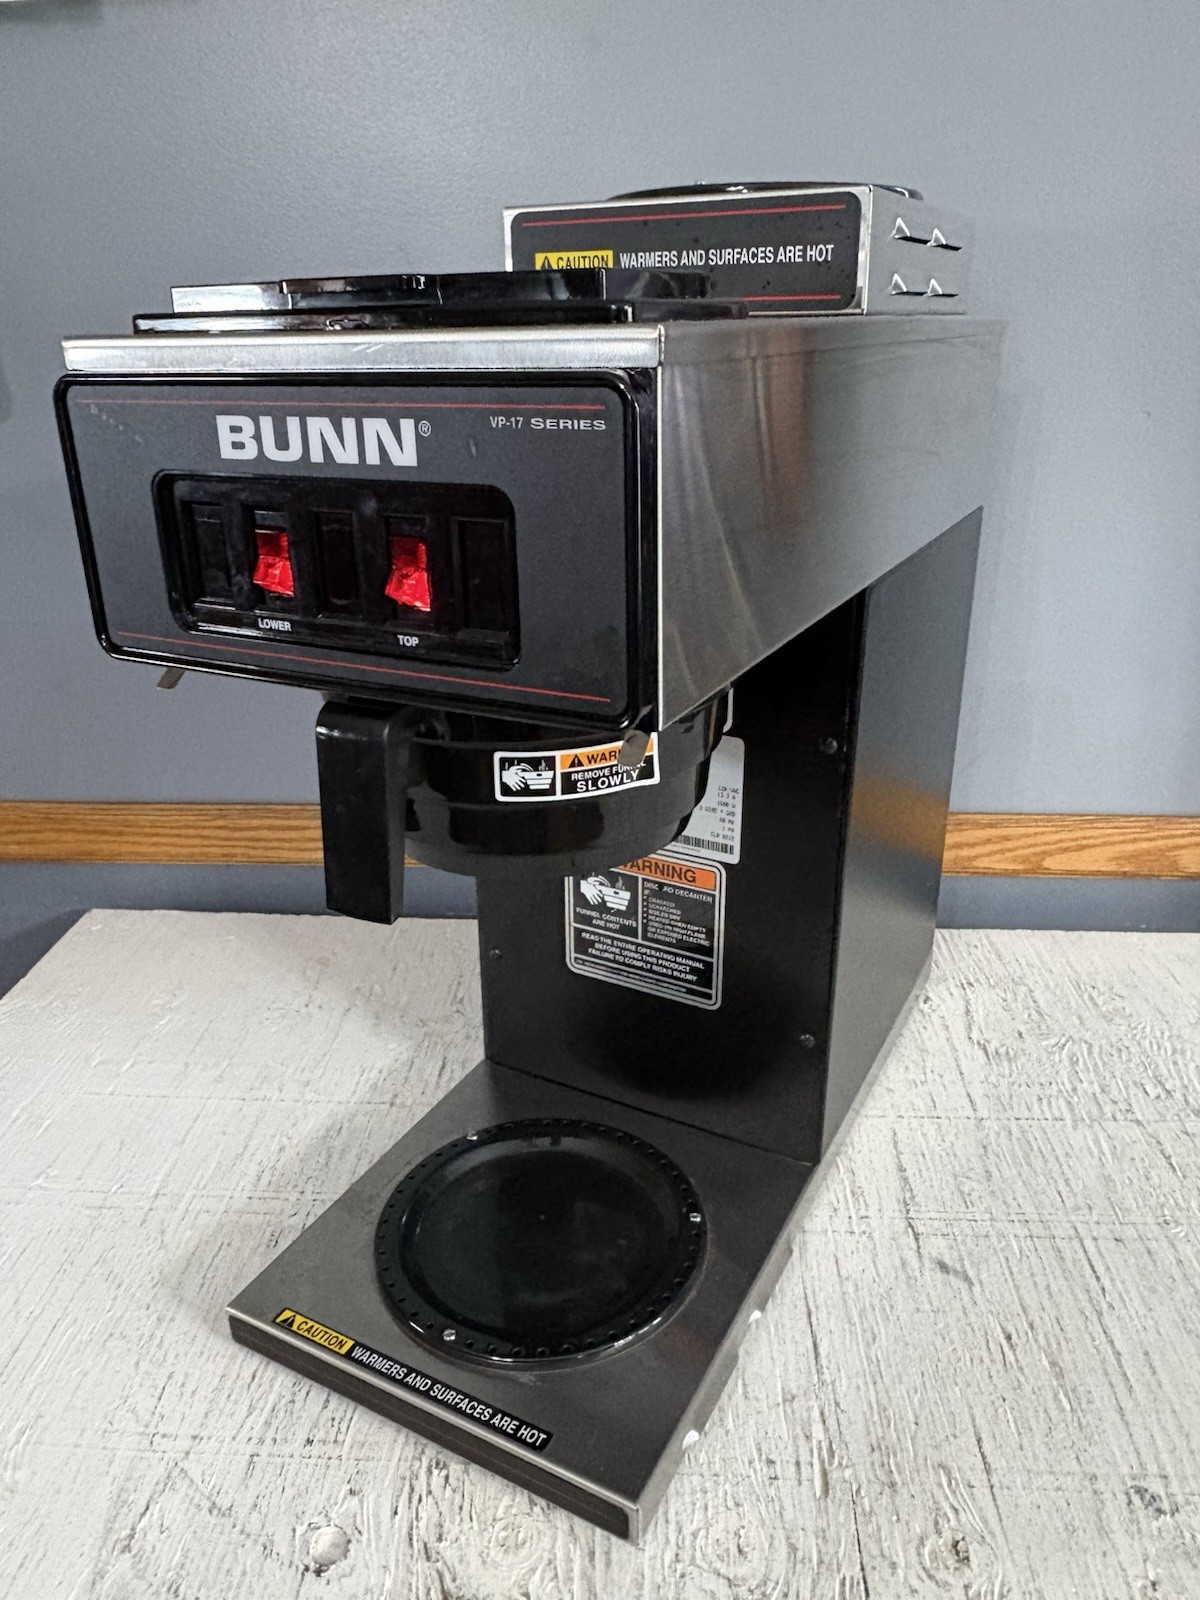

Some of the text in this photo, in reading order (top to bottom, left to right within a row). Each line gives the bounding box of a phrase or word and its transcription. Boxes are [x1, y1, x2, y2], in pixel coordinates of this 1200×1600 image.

[556, 244, 834, 269] CAUTION WARMERS AND SURFACES ARE HOT
[490, 416, 606, 430] VP-17 SERIES
[258, 618, 292, 632] LOWER
[397, 634, 419, 647] TOP
[571, 767, 611, 781] REMOVE
[577, 769, 640, 792] SLOWLY
[625, 859, 696, 883] ARNING
[297, 1321, 547, 1446] CAUTION WARMERS AND SURFACES ARE HOT
